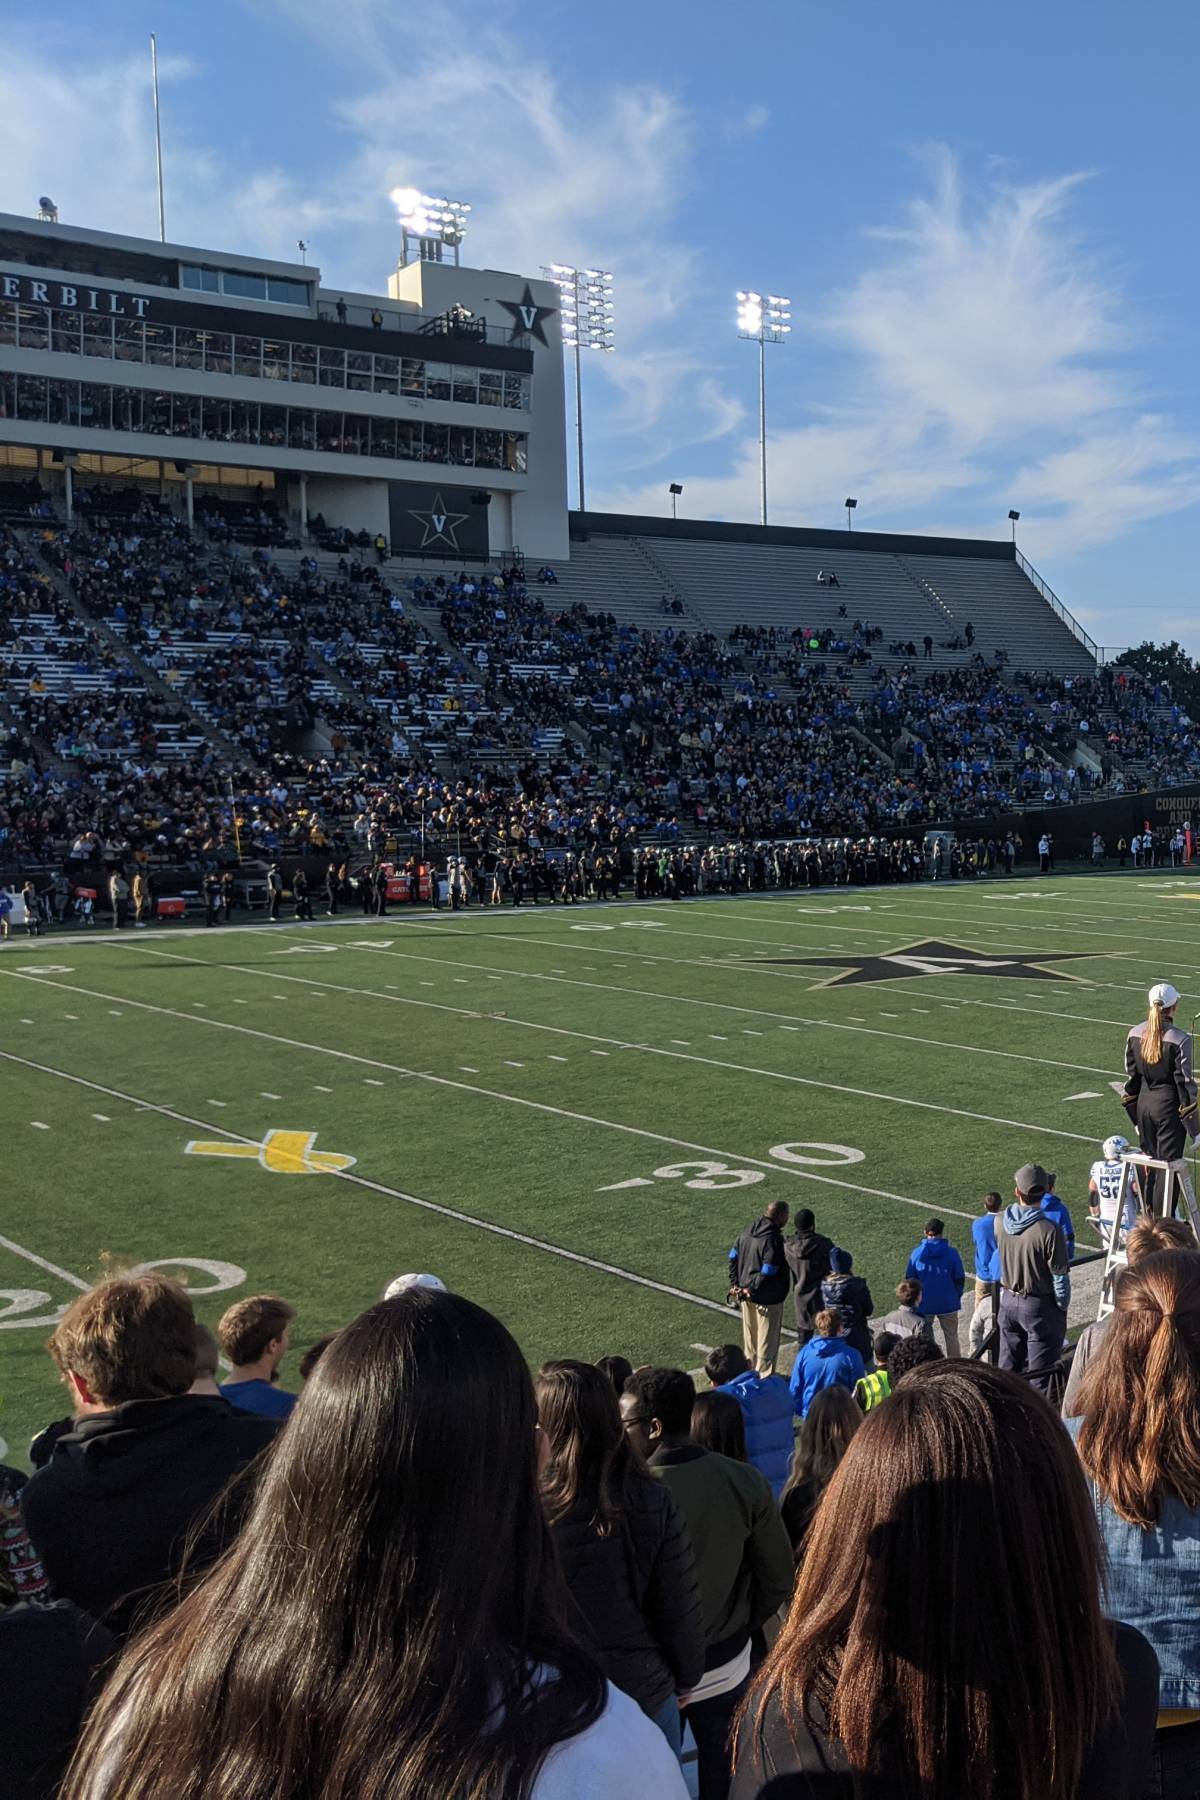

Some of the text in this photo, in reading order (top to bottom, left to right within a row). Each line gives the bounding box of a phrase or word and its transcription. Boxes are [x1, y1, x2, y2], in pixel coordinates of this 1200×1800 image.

[520, 306, 537, 329] V
[432, 514, 447, 532] V
[1169, 811, 1192, 823] AND
[652, 1142, 867, 1190] 30
